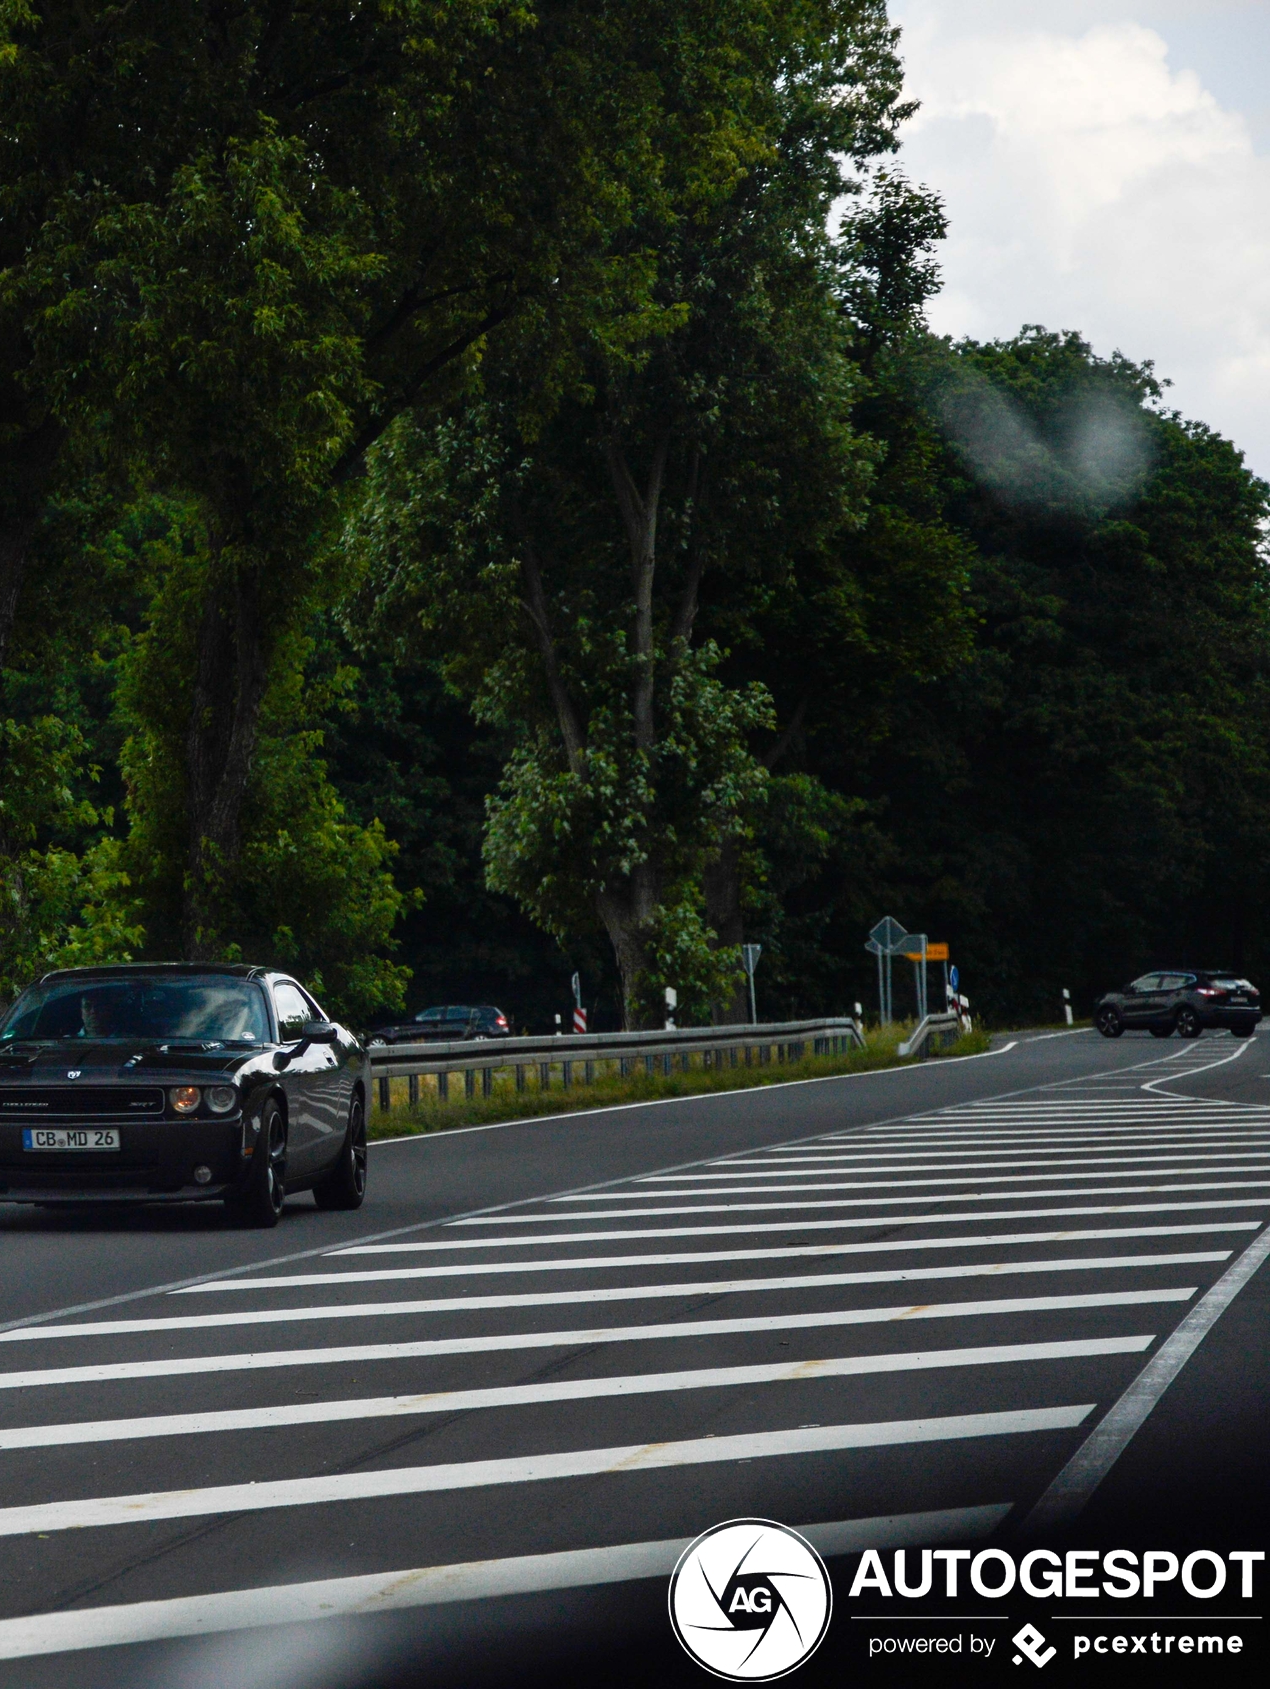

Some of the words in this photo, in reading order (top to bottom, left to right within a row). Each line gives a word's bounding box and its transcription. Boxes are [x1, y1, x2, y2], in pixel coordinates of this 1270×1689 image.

[36, 1131, 56, 1147] CB
[66, 1131, 88, 1147] MD
[94, 1131, 114, 1146] 26
